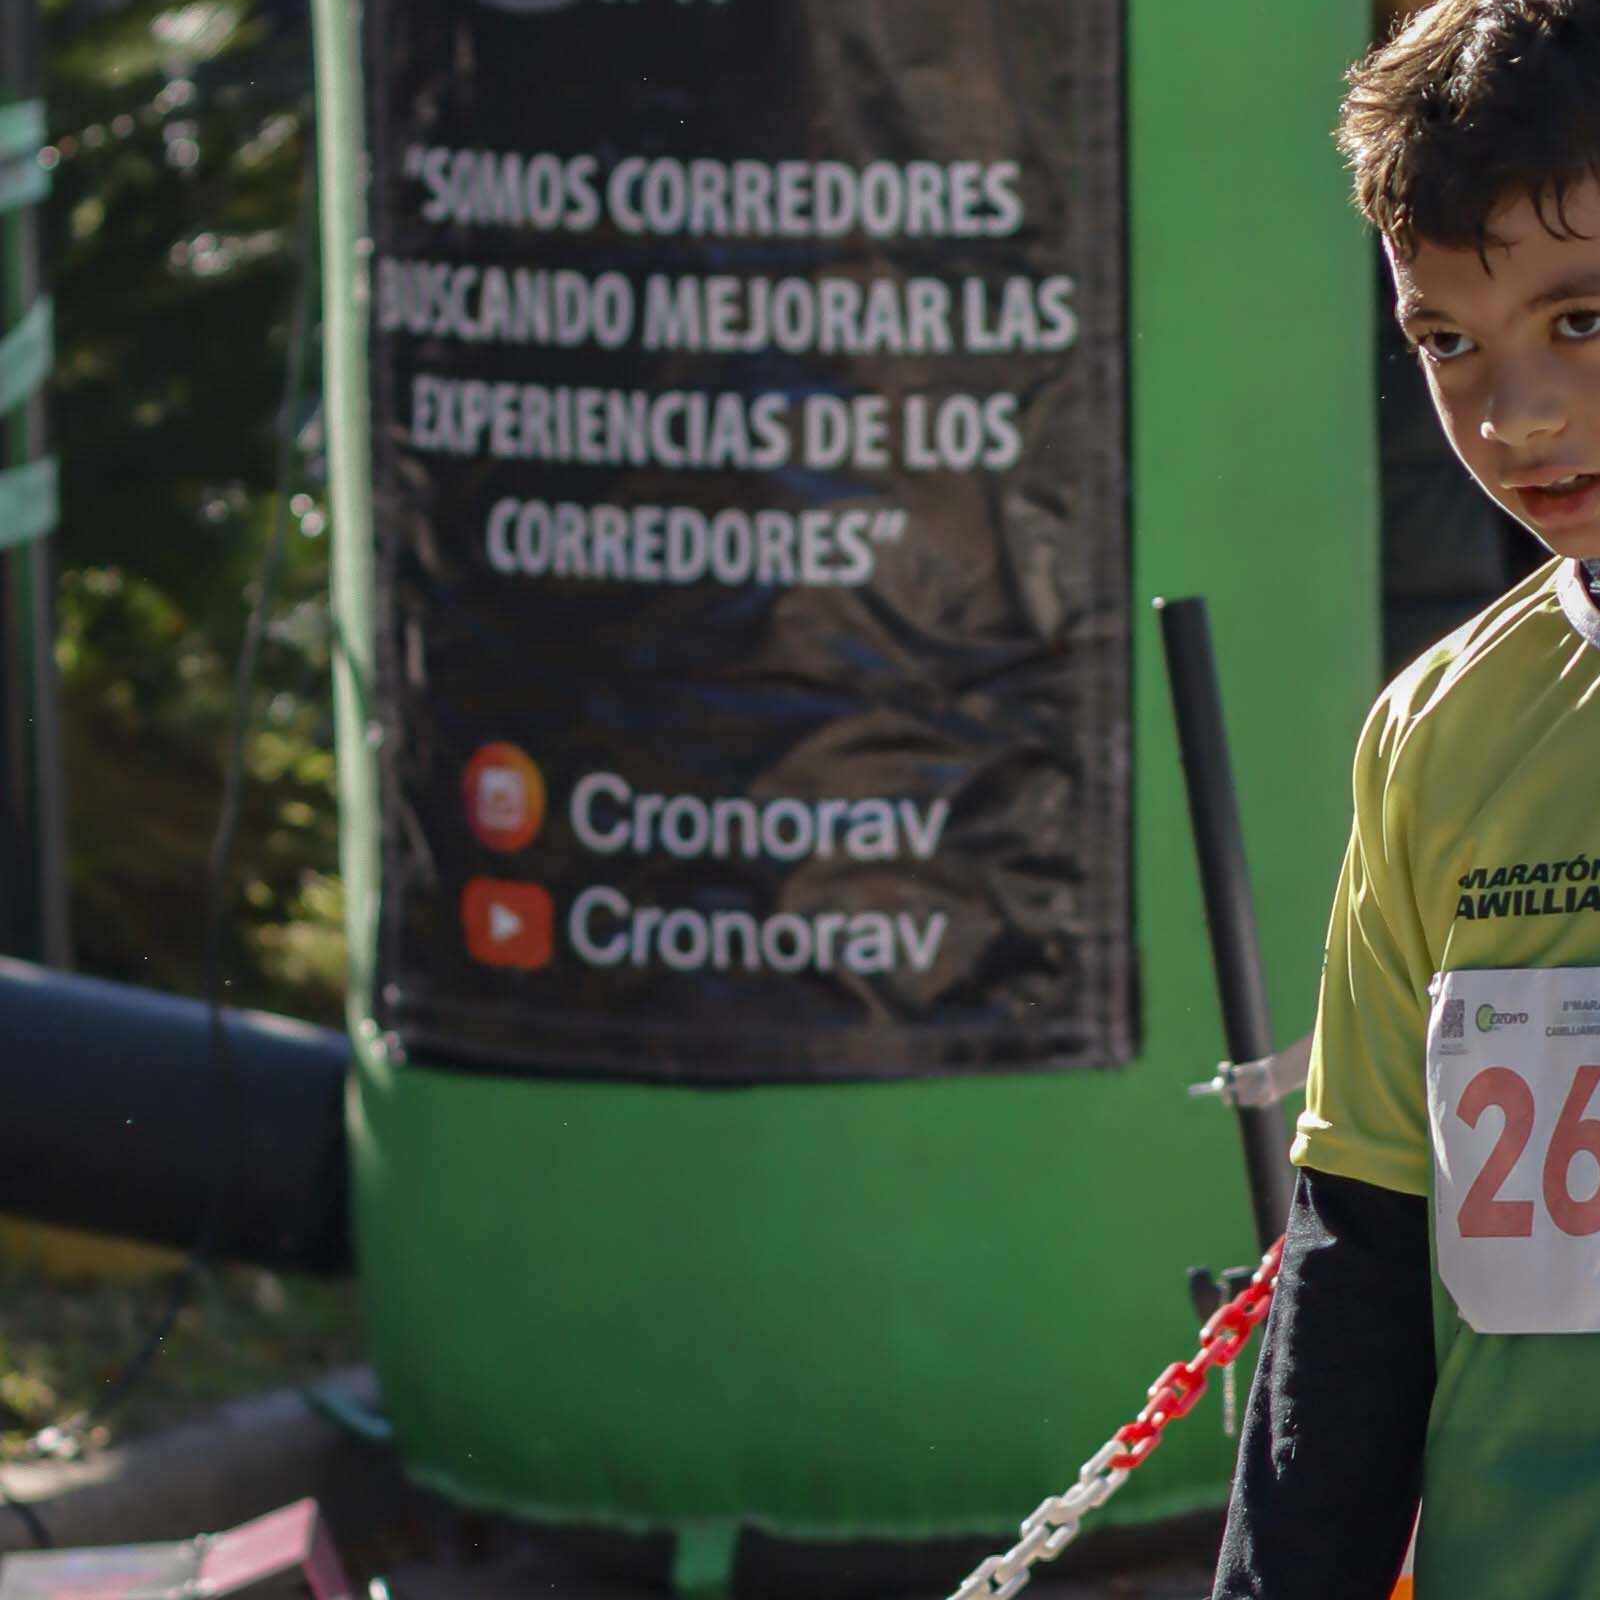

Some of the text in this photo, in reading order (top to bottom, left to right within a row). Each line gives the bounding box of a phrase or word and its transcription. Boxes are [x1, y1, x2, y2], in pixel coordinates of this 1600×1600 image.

[607, 157, 1024, 237] CORREDORES
[377, 256, 1079, 354] BUSCANDO MEJORAR LAS
[410, 373, 1022, 470] EXPERIENCIAS DE LOS
[570, 771, 949, 861] Cronorav
[568, 886, 948, 973] Cronorav
